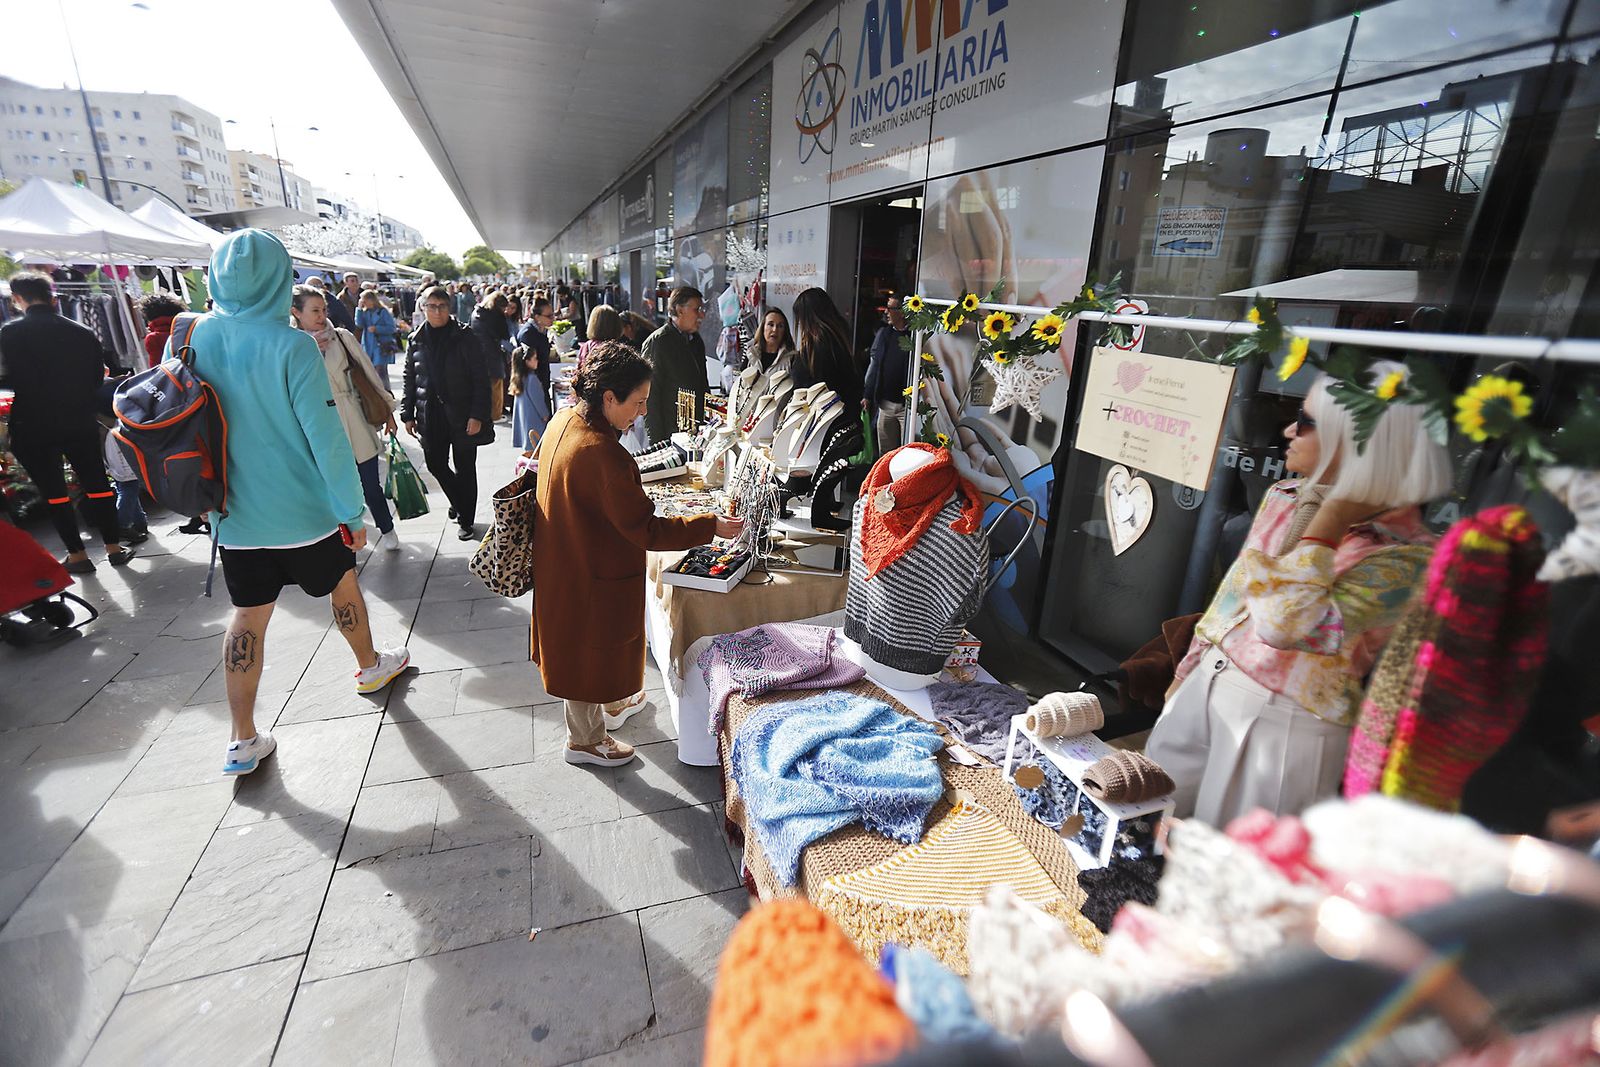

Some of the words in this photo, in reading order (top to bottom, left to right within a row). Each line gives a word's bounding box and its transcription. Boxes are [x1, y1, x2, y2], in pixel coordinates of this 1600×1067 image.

[849, 129, 872, 146] GRUPO
[872, 114, 899, 139] MARTÍN
[899, 99, 938, 127] SÁNCHEZ
[939, 72, 1006, 111] CONSULTING
[850, 20, 1008, 129] INMOBILIARIA
